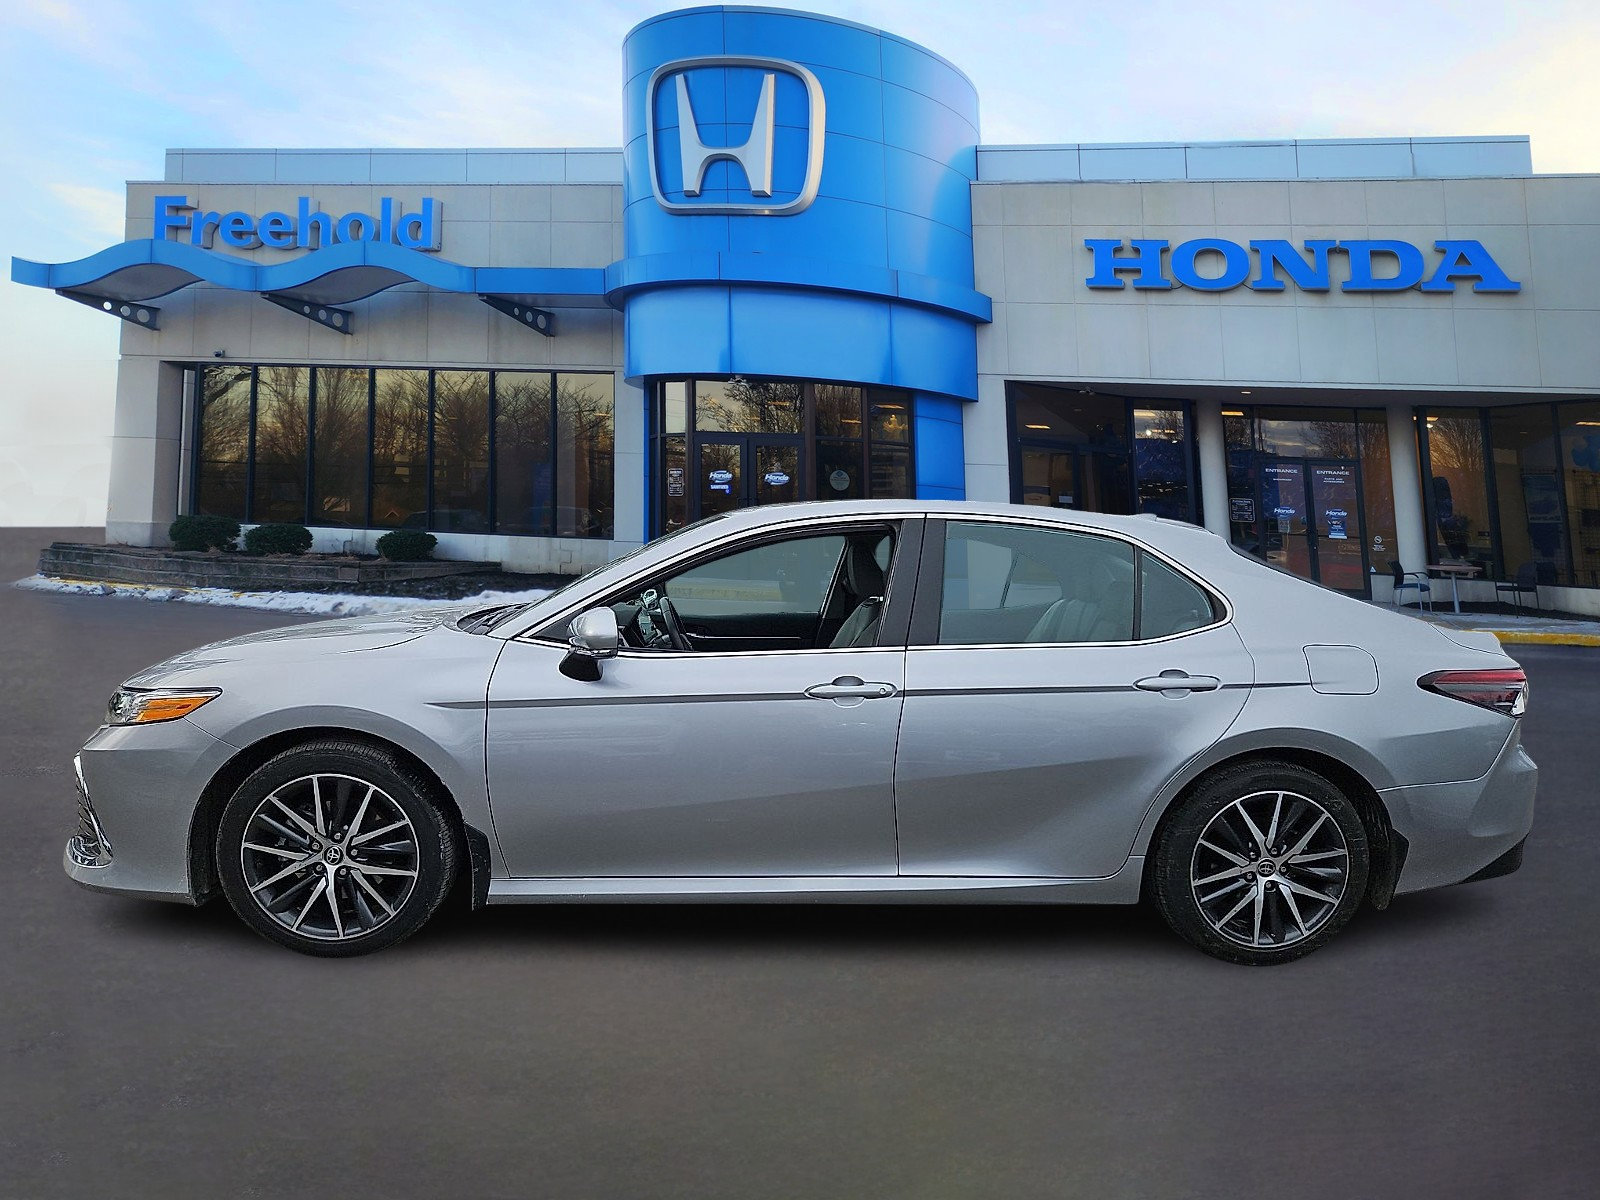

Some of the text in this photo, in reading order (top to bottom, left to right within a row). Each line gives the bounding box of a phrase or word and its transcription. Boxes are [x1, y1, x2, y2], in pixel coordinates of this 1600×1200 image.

[154, 195, 440, 249] Freehold
[1084, 238, 1521, 292] HONDA
[709, 472, 733, 480] Honda
[765, 474, 790, 482] Honda
